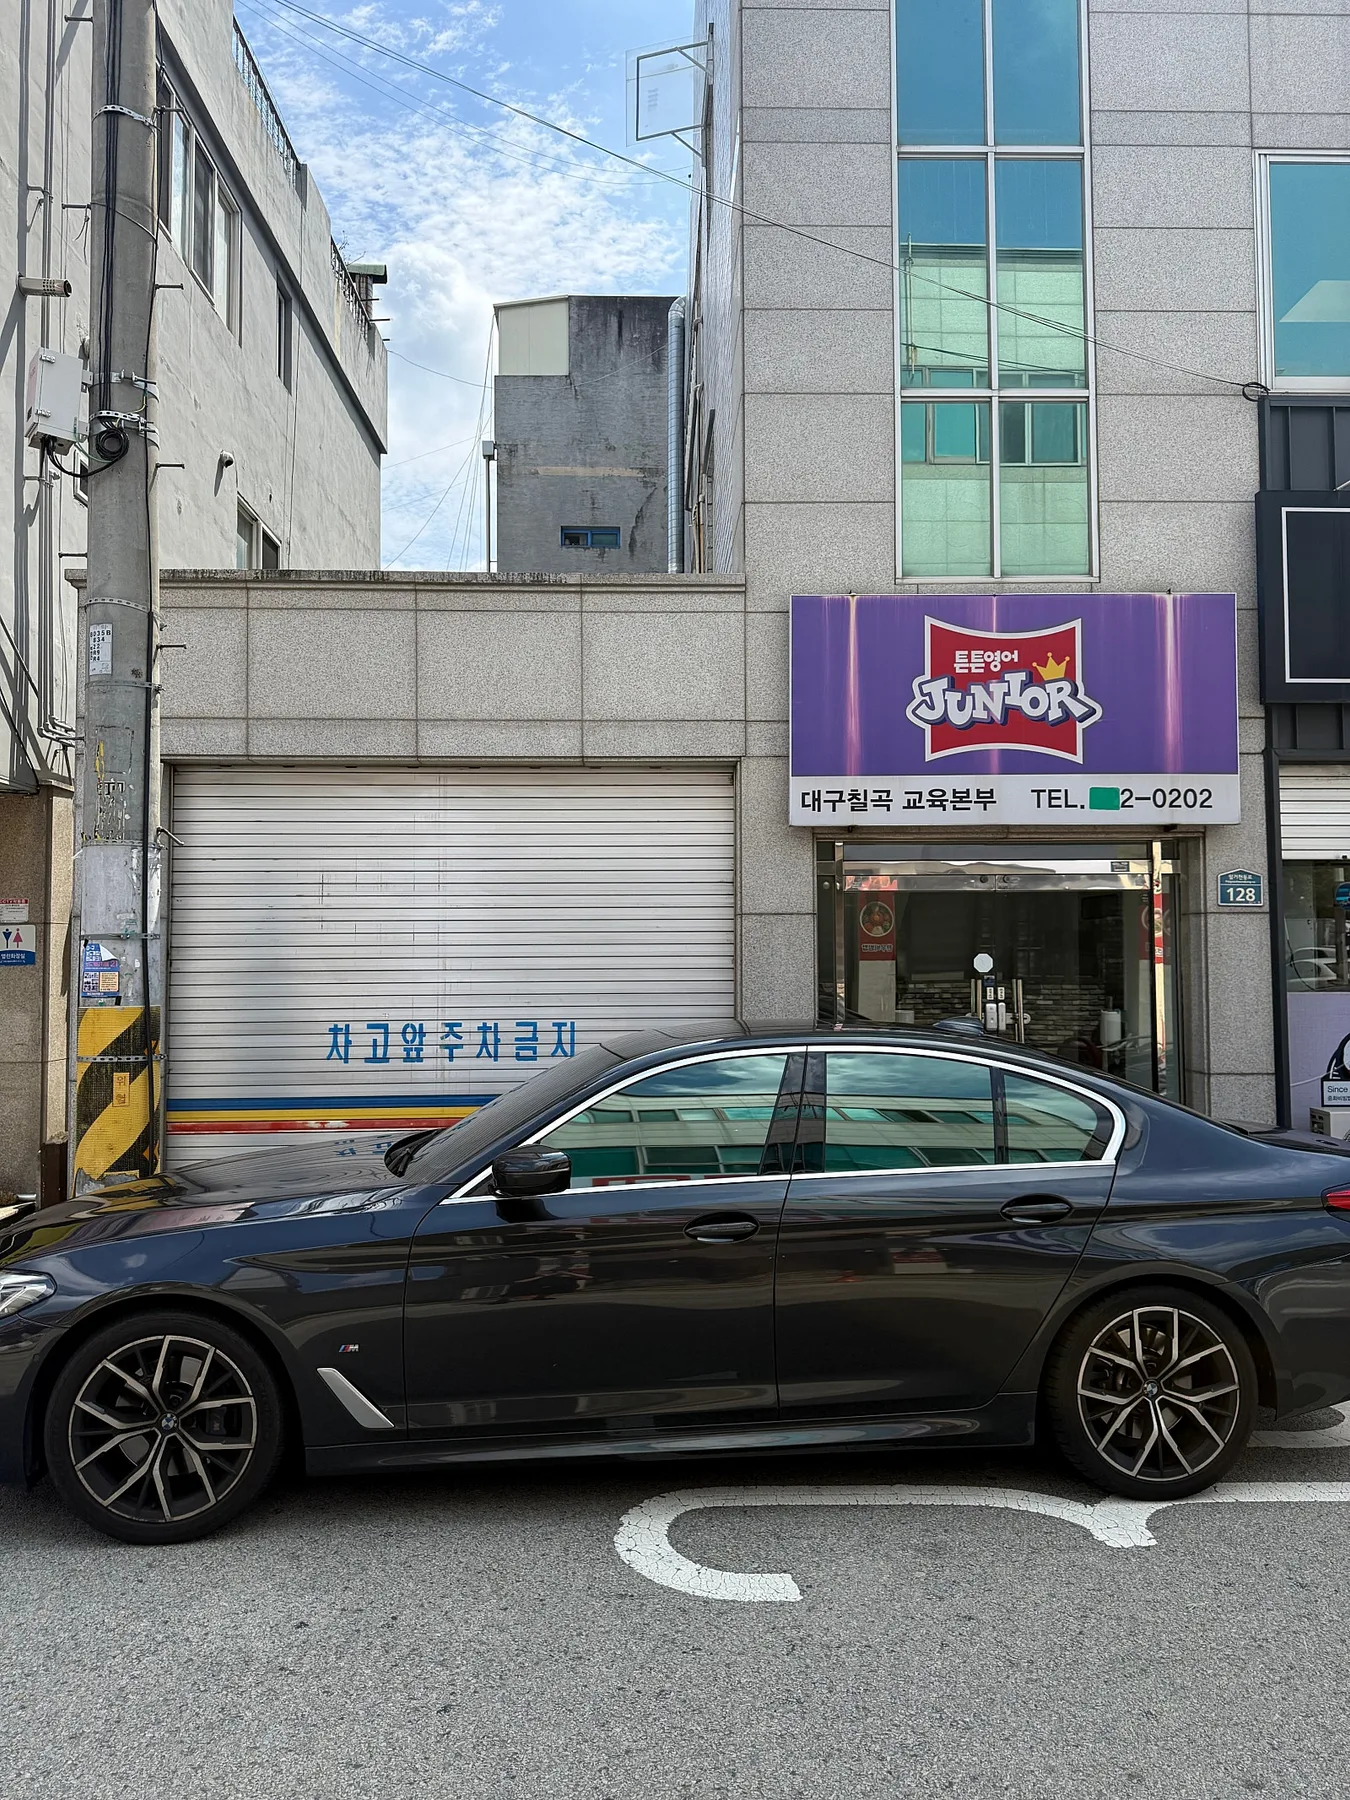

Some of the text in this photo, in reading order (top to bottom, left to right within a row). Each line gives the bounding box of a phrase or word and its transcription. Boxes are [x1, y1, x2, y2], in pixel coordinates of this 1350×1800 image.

[953, 650, 1019, 673] 튼튼영어
[915, 671, 1090, 727] JUNIOR
[800, 788, 894, 813] 대구칠곡
[901, 788, 997, 812] 교육본부
[1227, 887, 1255, 901] 128
[1327, 1085, 1348, 1093] Since
